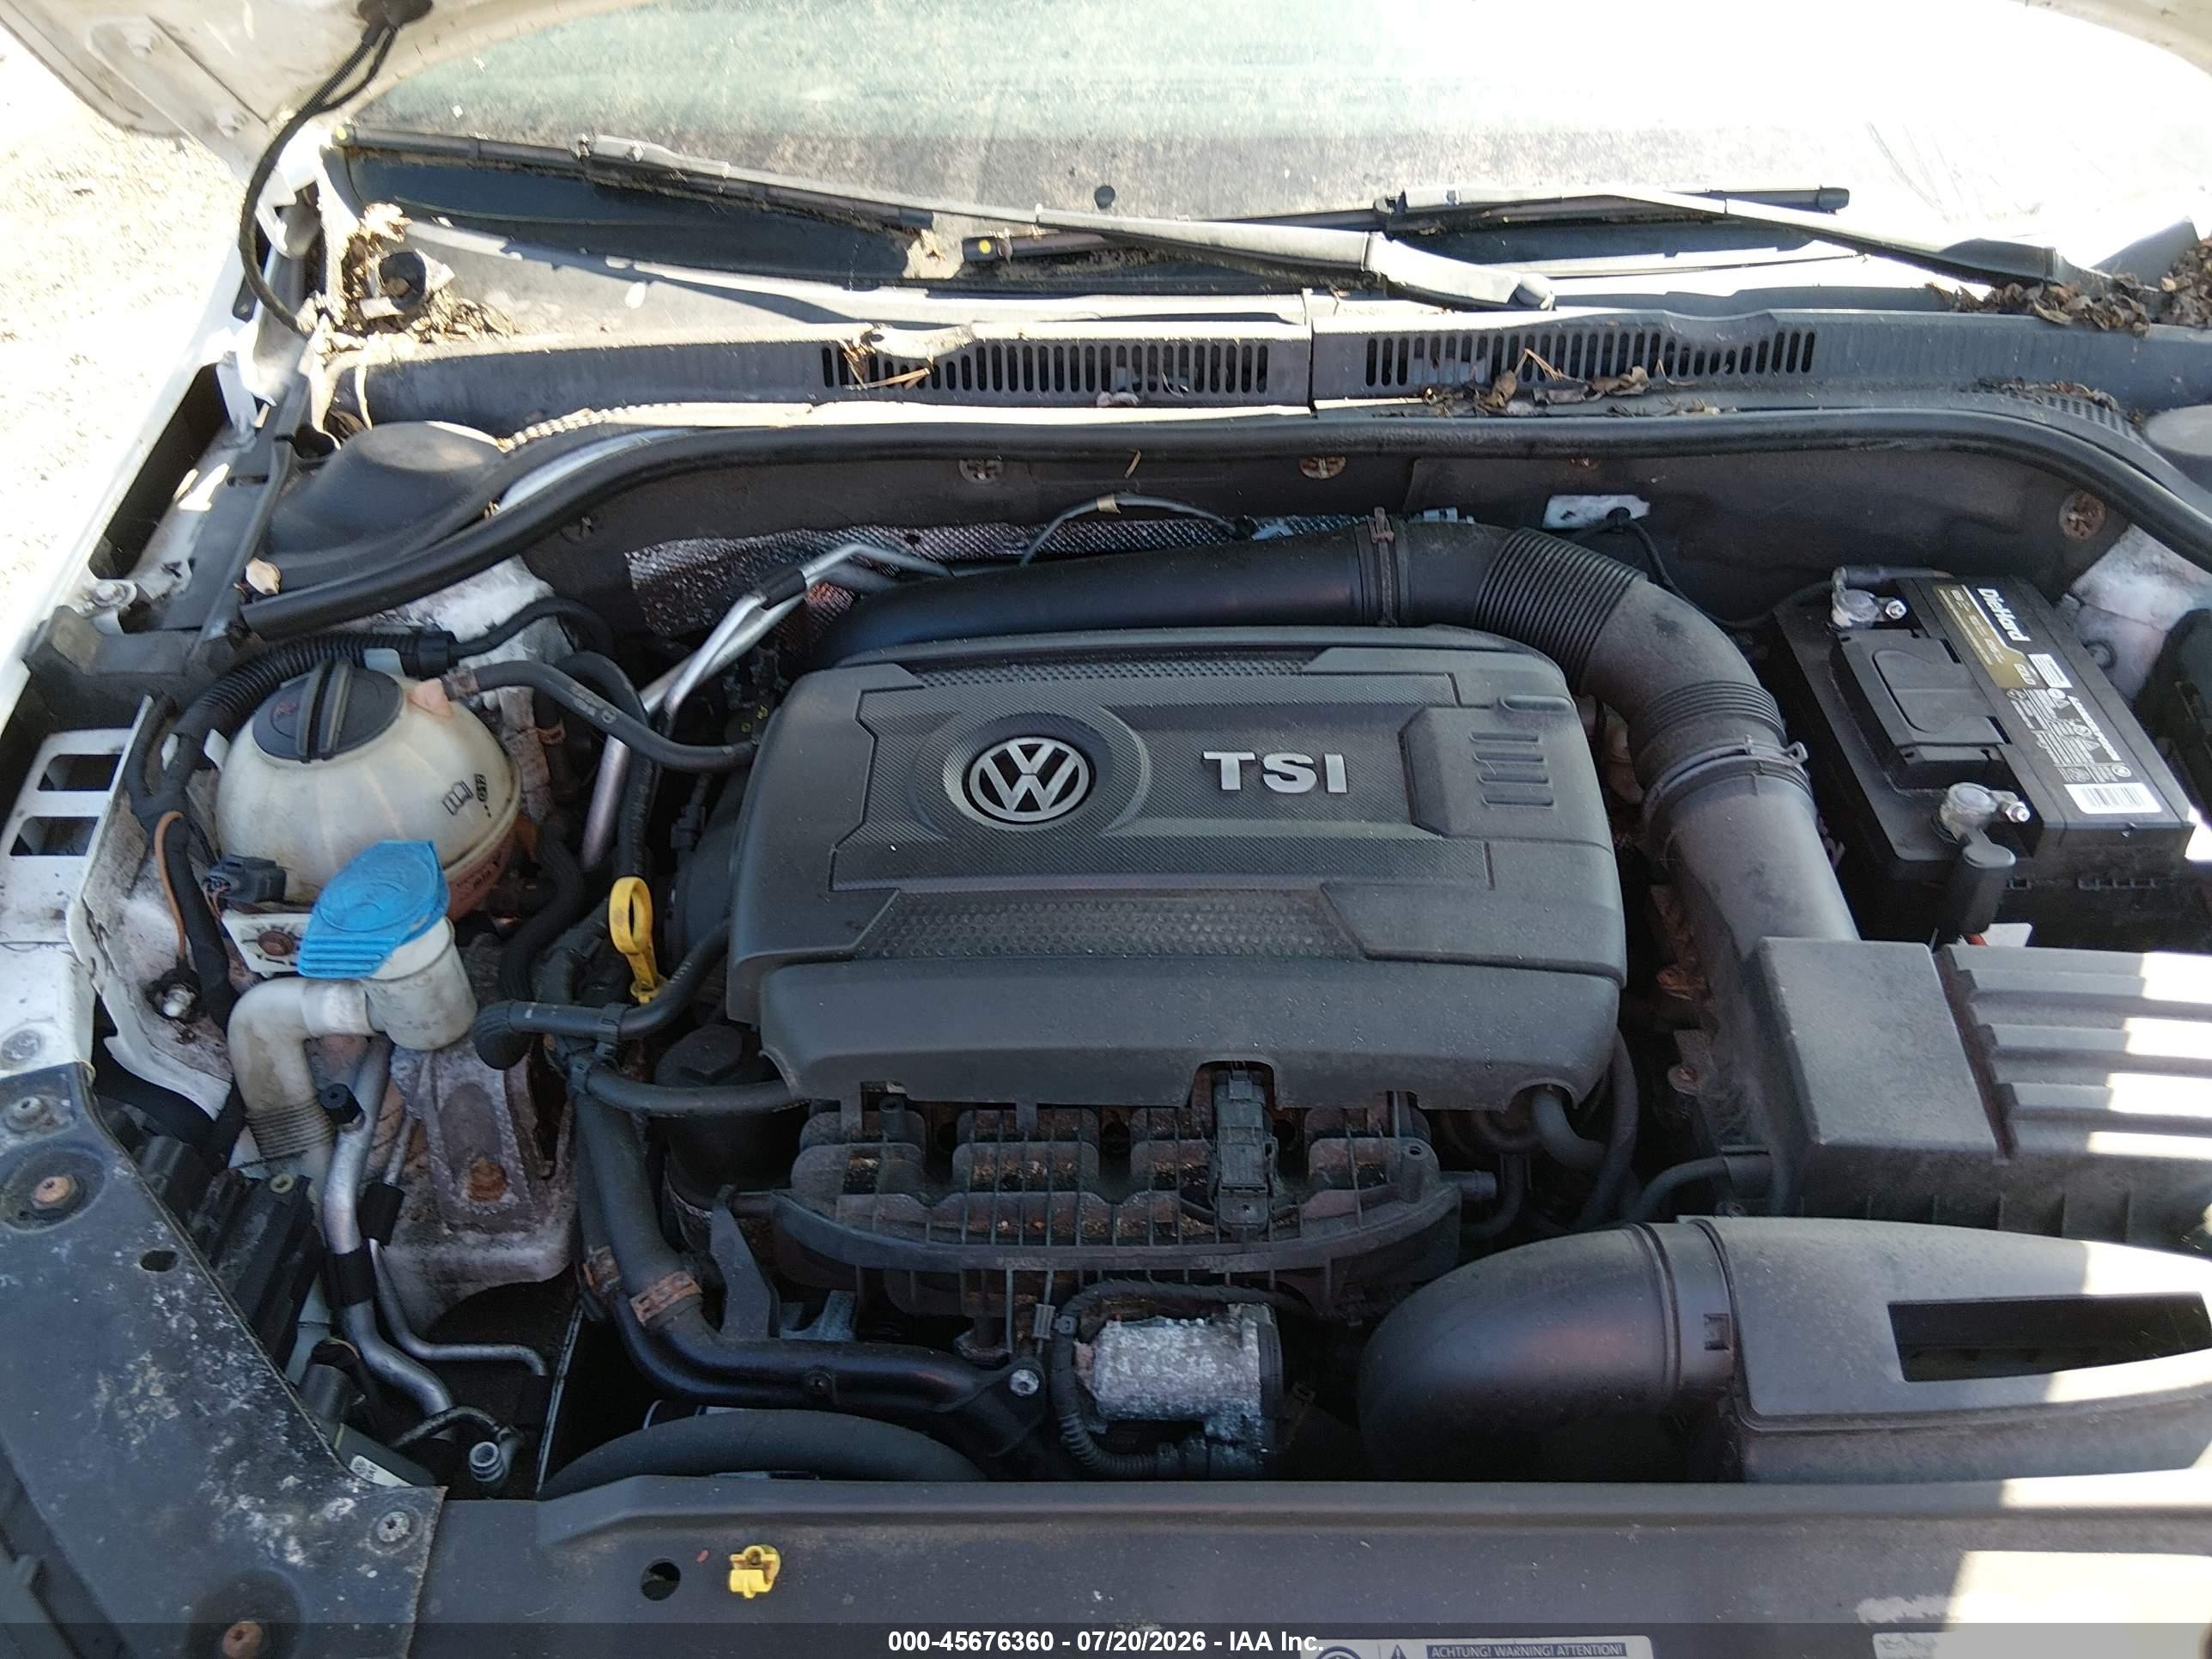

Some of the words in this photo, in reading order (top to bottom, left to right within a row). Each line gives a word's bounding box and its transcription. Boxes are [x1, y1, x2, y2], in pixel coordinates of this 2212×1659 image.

[1978, 588, 2031, 641] DieHard
[2014, 663, 2036, 685] GOLD
[1203, 751, 1347, 793] TSI
[1431, 1646, 1492, 1658] ACHTUNG!
[1495, 1645, 1555, 1657] WARNING!
[1556, 1644, 1624, 1656] ATTENTION!
